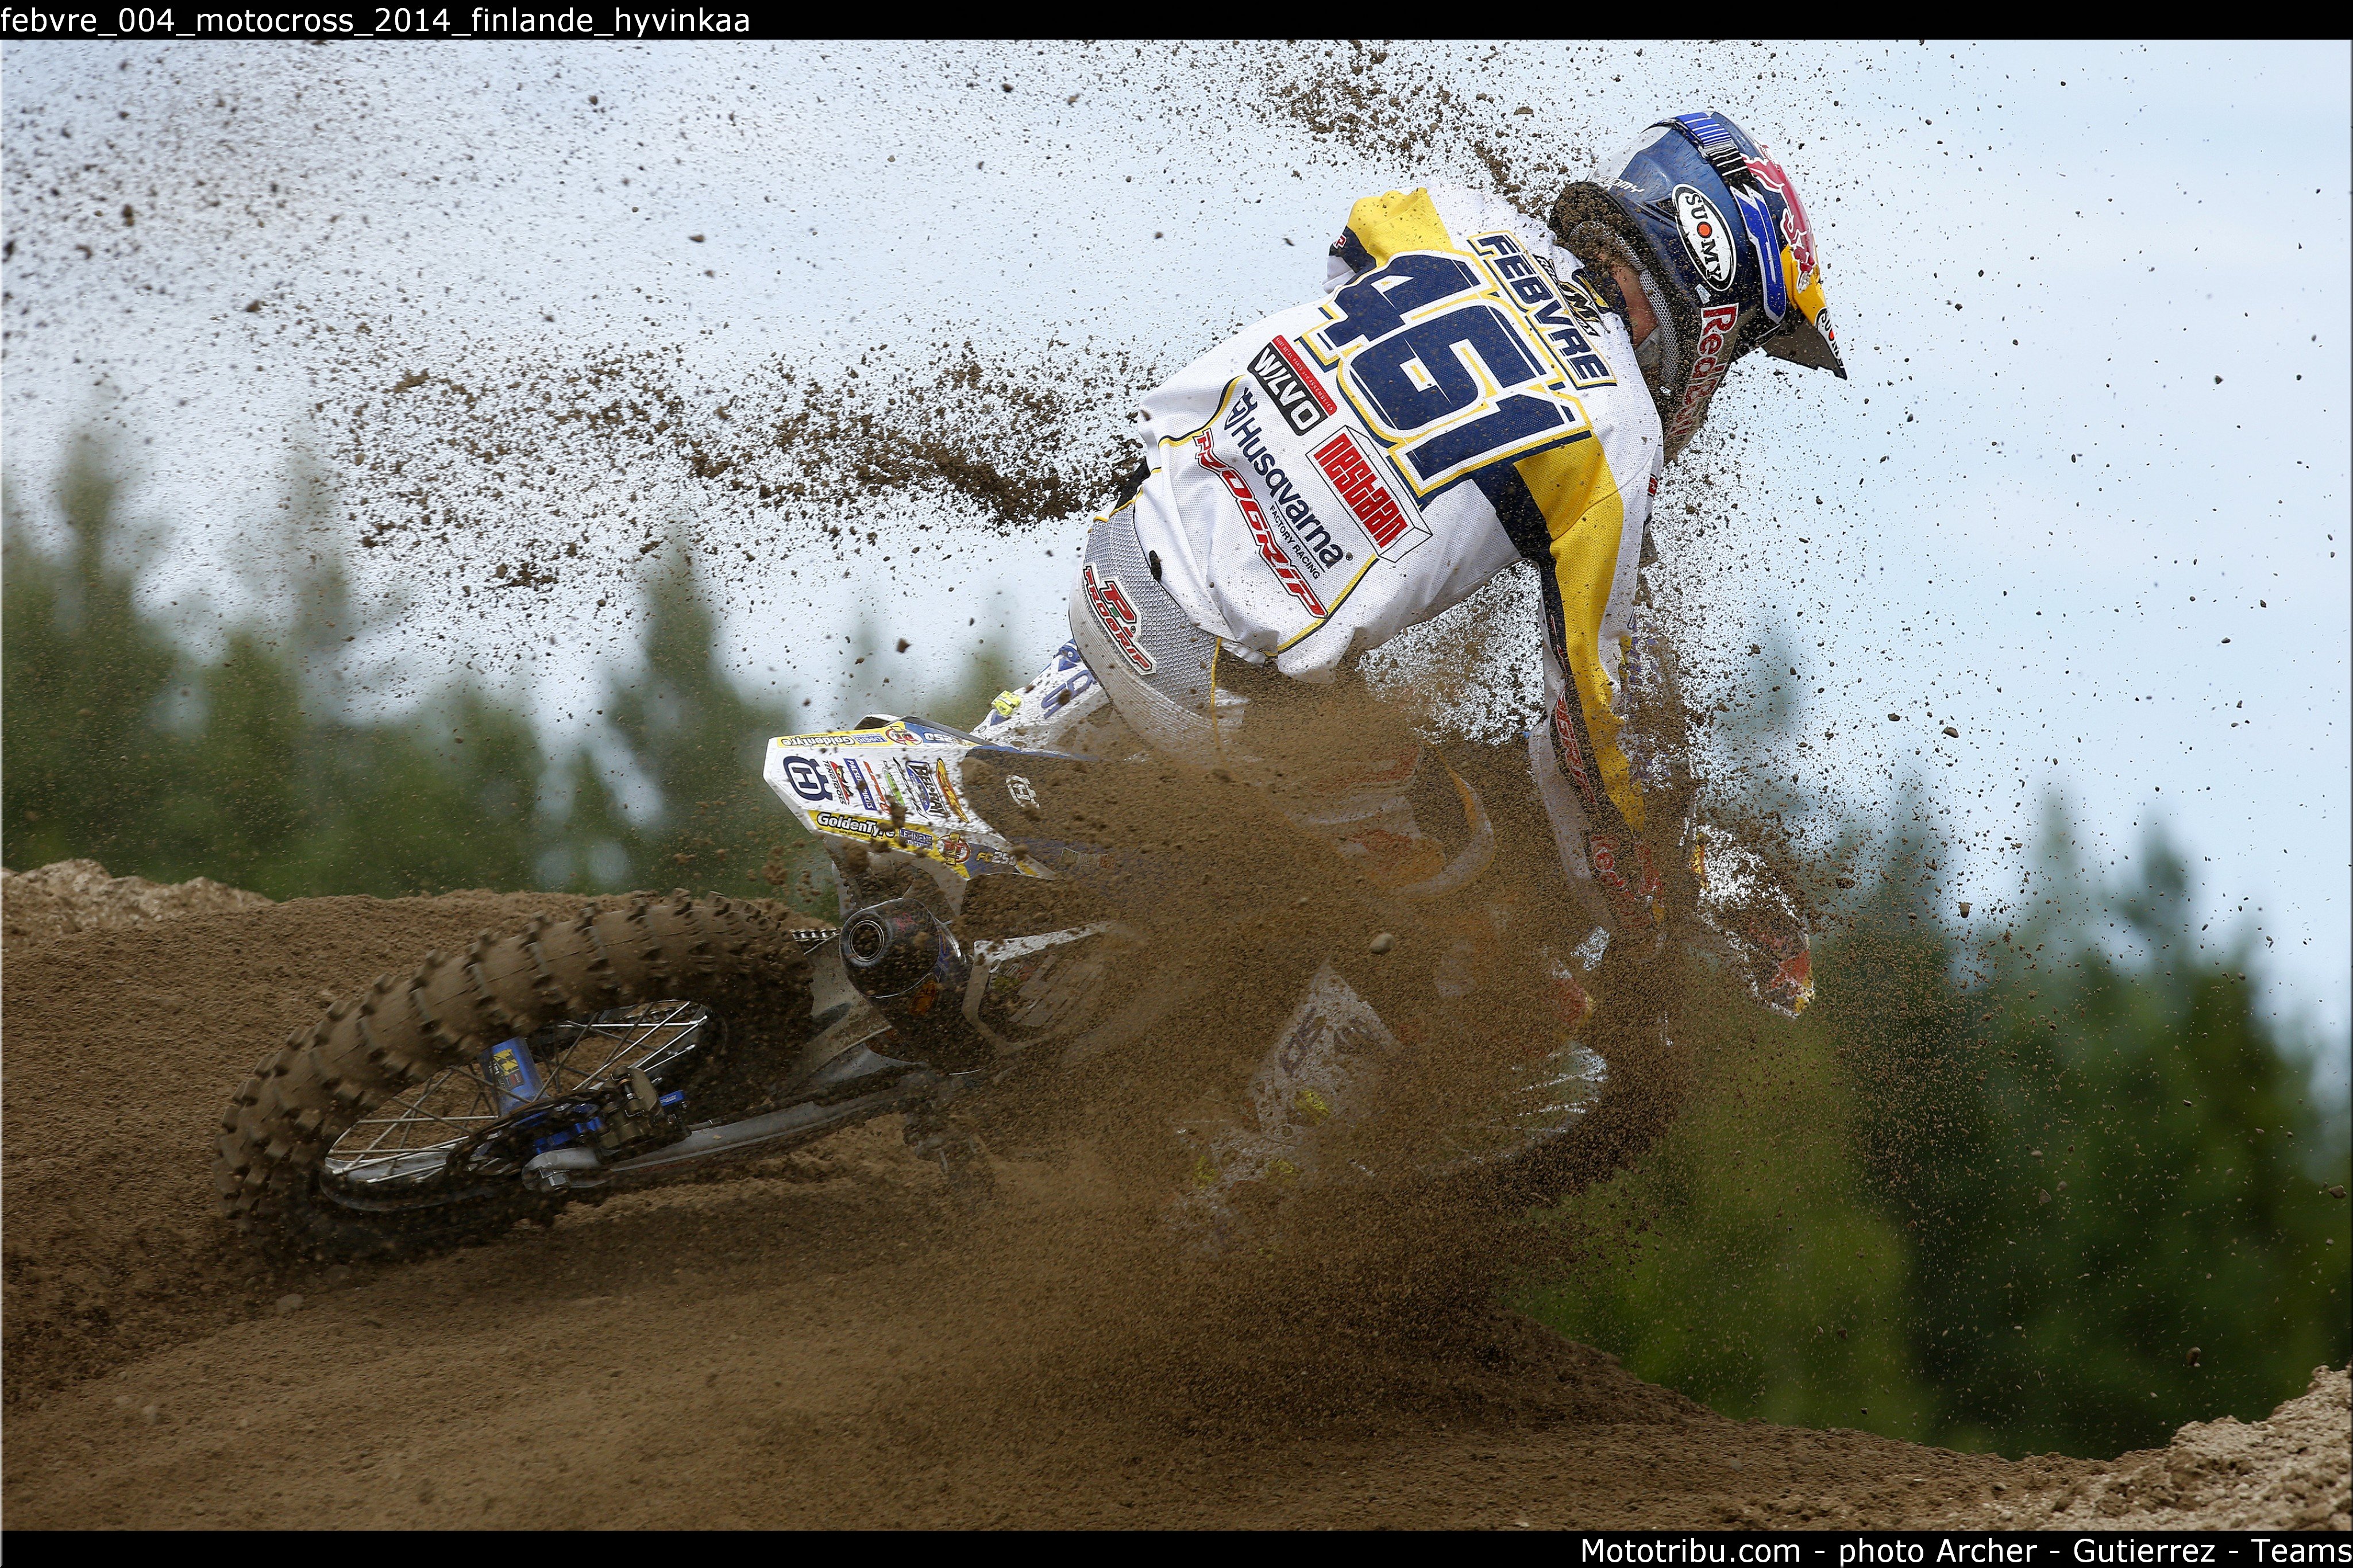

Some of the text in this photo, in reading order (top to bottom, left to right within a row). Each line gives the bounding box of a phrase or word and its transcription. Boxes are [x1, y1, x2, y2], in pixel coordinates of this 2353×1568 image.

[1684, 193, 1723, 280] SUOMY
[1476, 233, 1611, 380] FEBVRE
[1254, 347, 1321, 432] WLVO
[1293, 358, 1303, 371] PARTS
[1309, 379, 1333, 411] ASSEMBLIES
[1311, 250, 1587, 493] 461
[1231, 418, 1343, 569] Husqvarna
[1270, 505, 1320, 580] FACTORY RACING
[1085, 567, 1151, 669] PROGRIP
[781, 736, 856, 746] GoldenTyre
